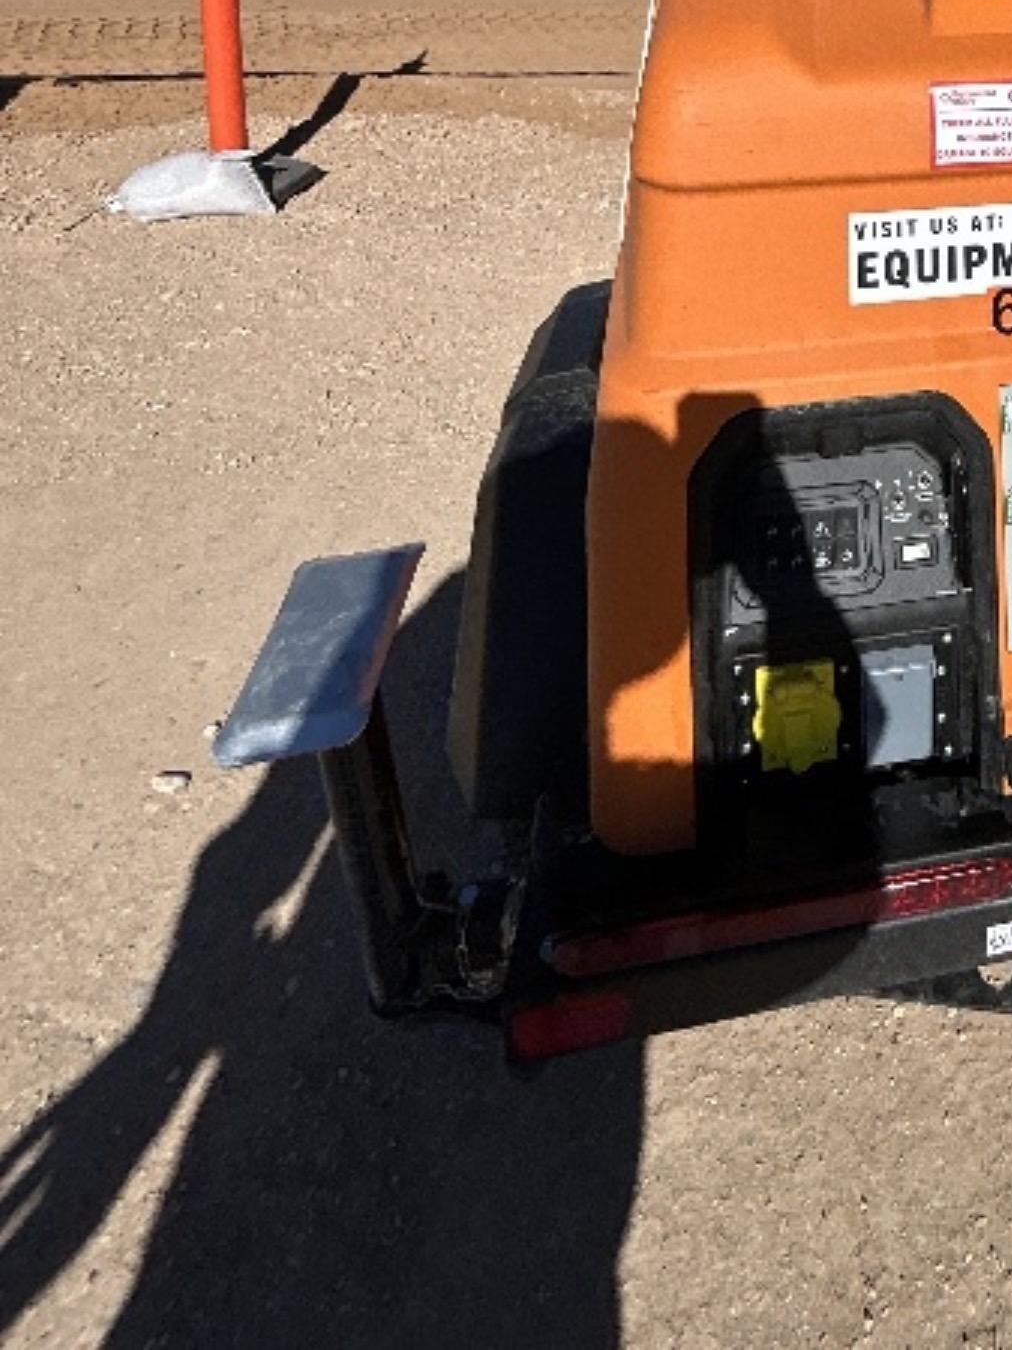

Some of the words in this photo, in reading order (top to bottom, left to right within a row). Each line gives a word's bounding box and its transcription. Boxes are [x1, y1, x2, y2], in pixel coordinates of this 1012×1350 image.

[854, 218, 918, 242] VISIT
[929, 216, 958, 235] US
[971, 213, 1003, 233] AT:
